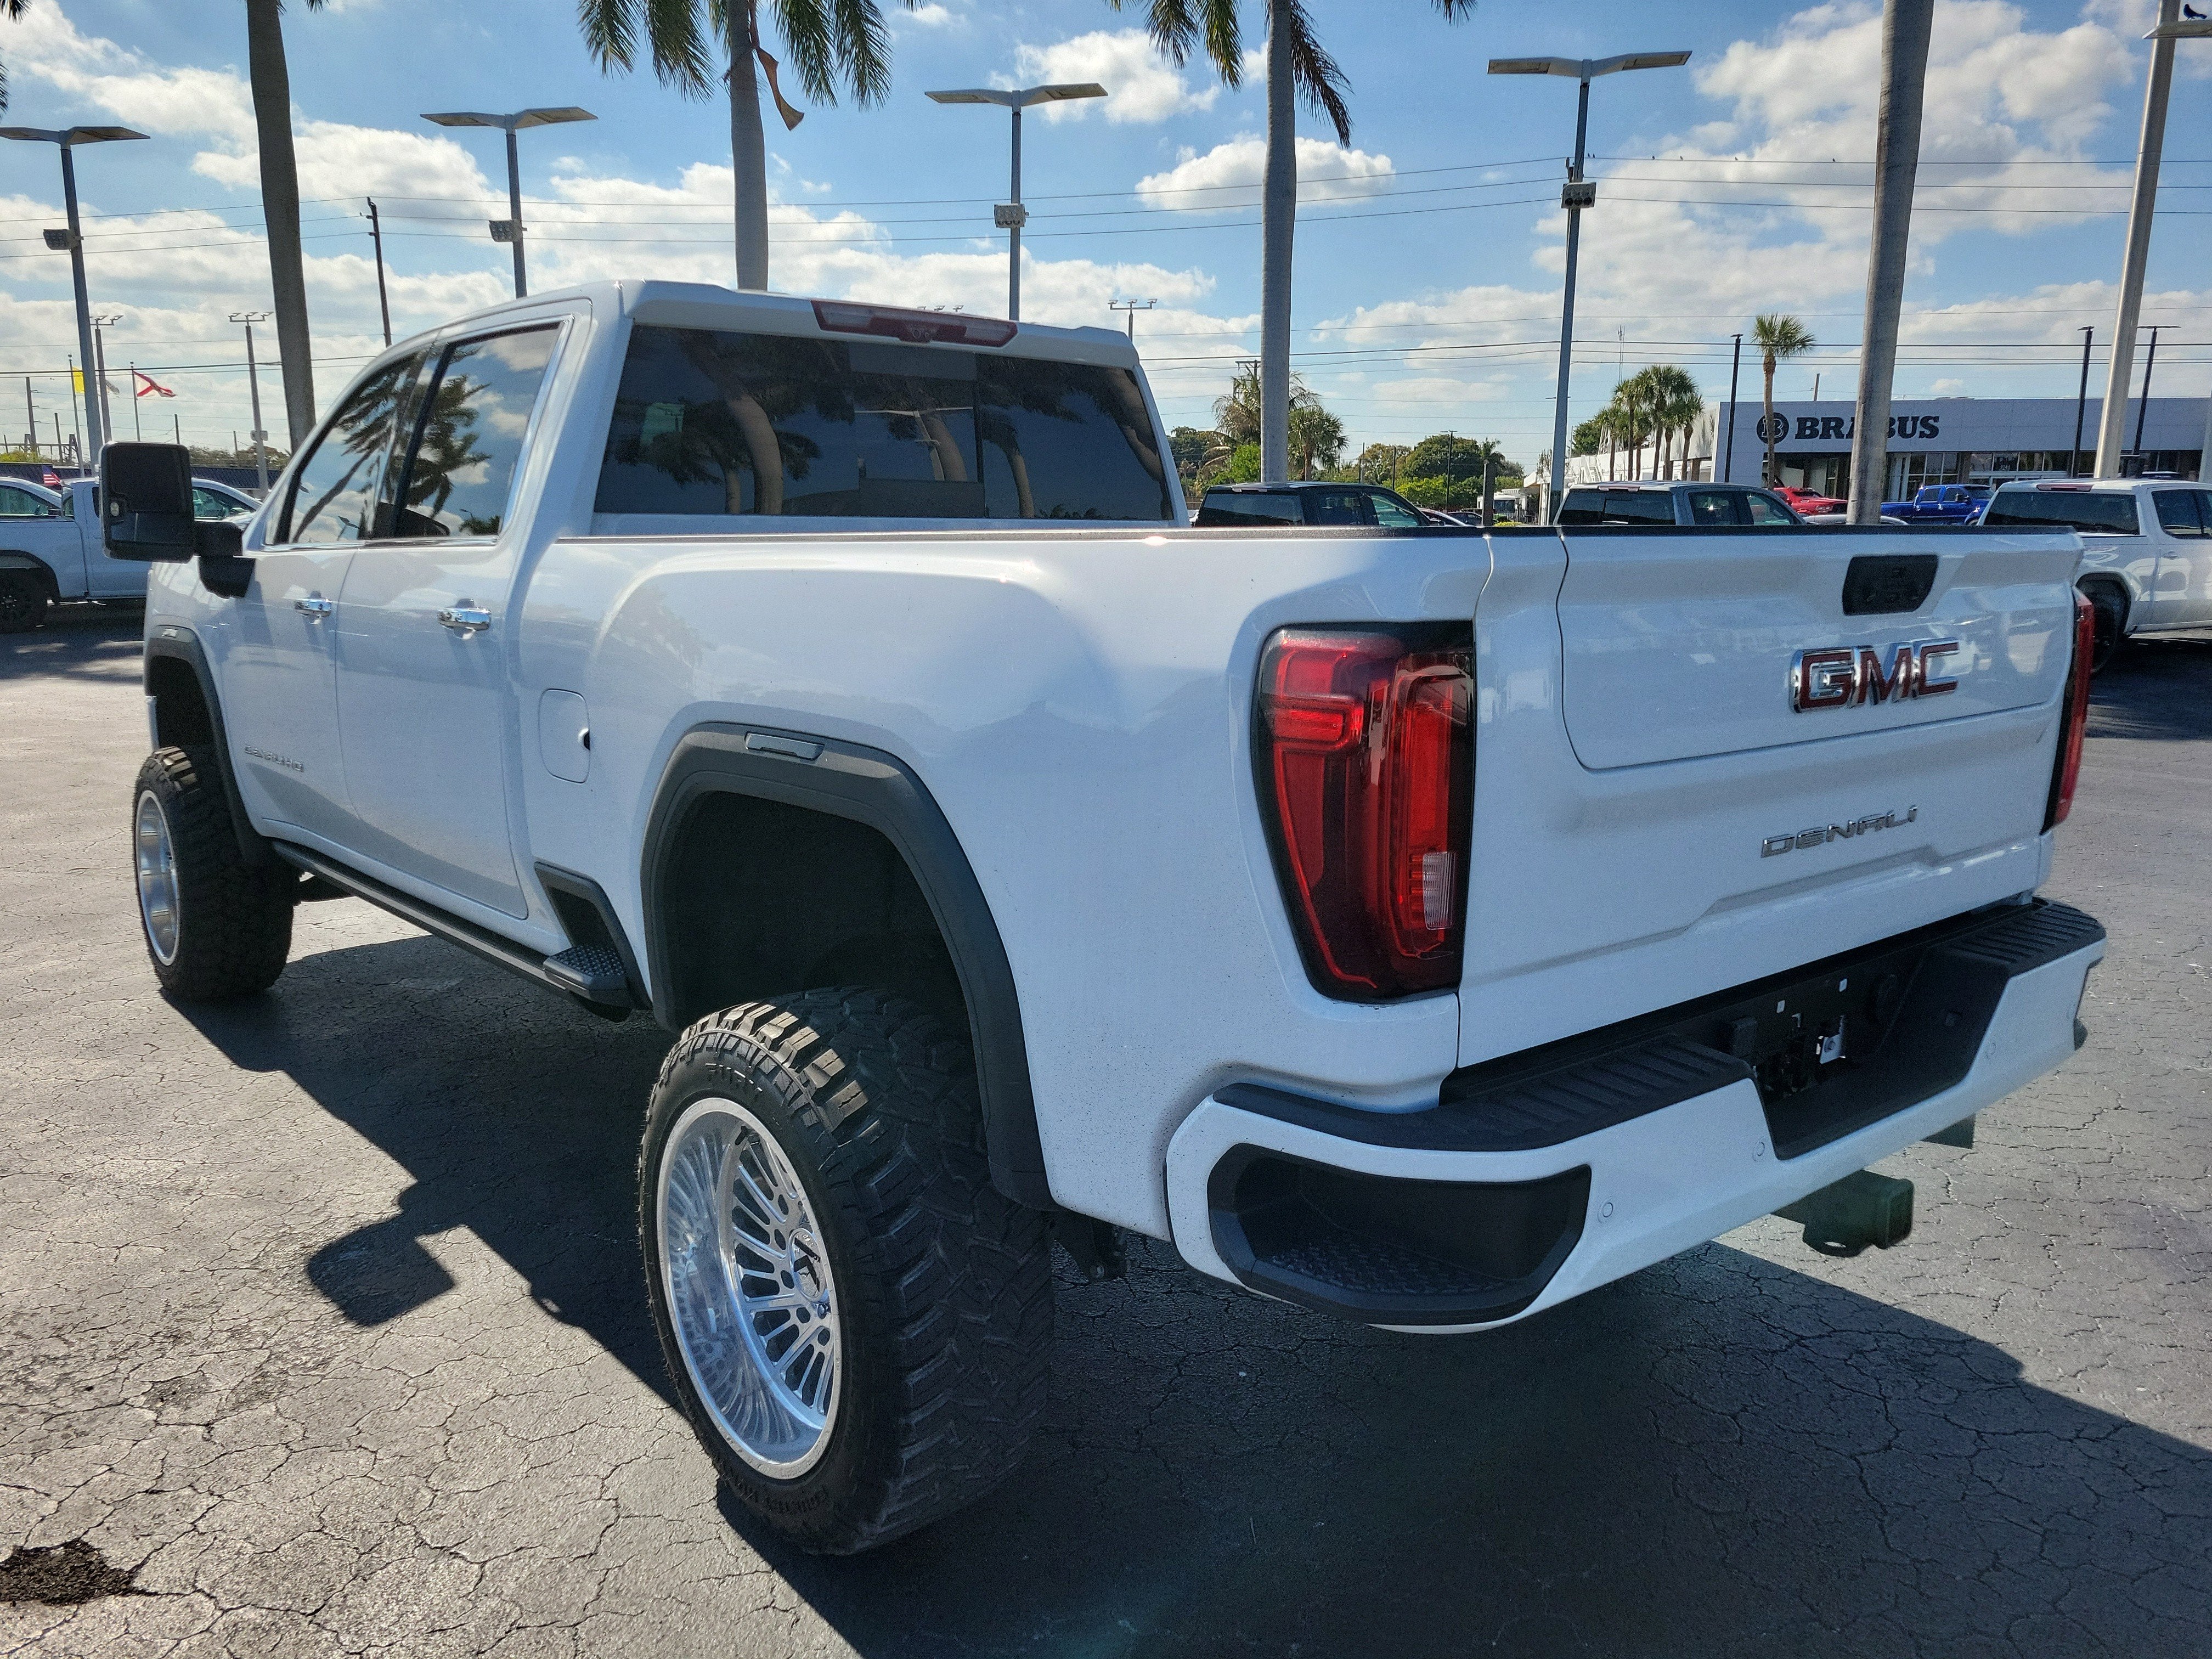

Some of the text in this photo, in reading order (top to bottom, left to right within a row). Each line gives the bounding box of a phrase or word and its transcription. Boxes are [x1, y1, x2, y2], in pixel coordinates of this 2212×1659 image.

[1795, 415, 1939, 439] BRUS
[1788, 636, 1960, 714] GMC
[1760, 804, 1918, 859] DENALI
